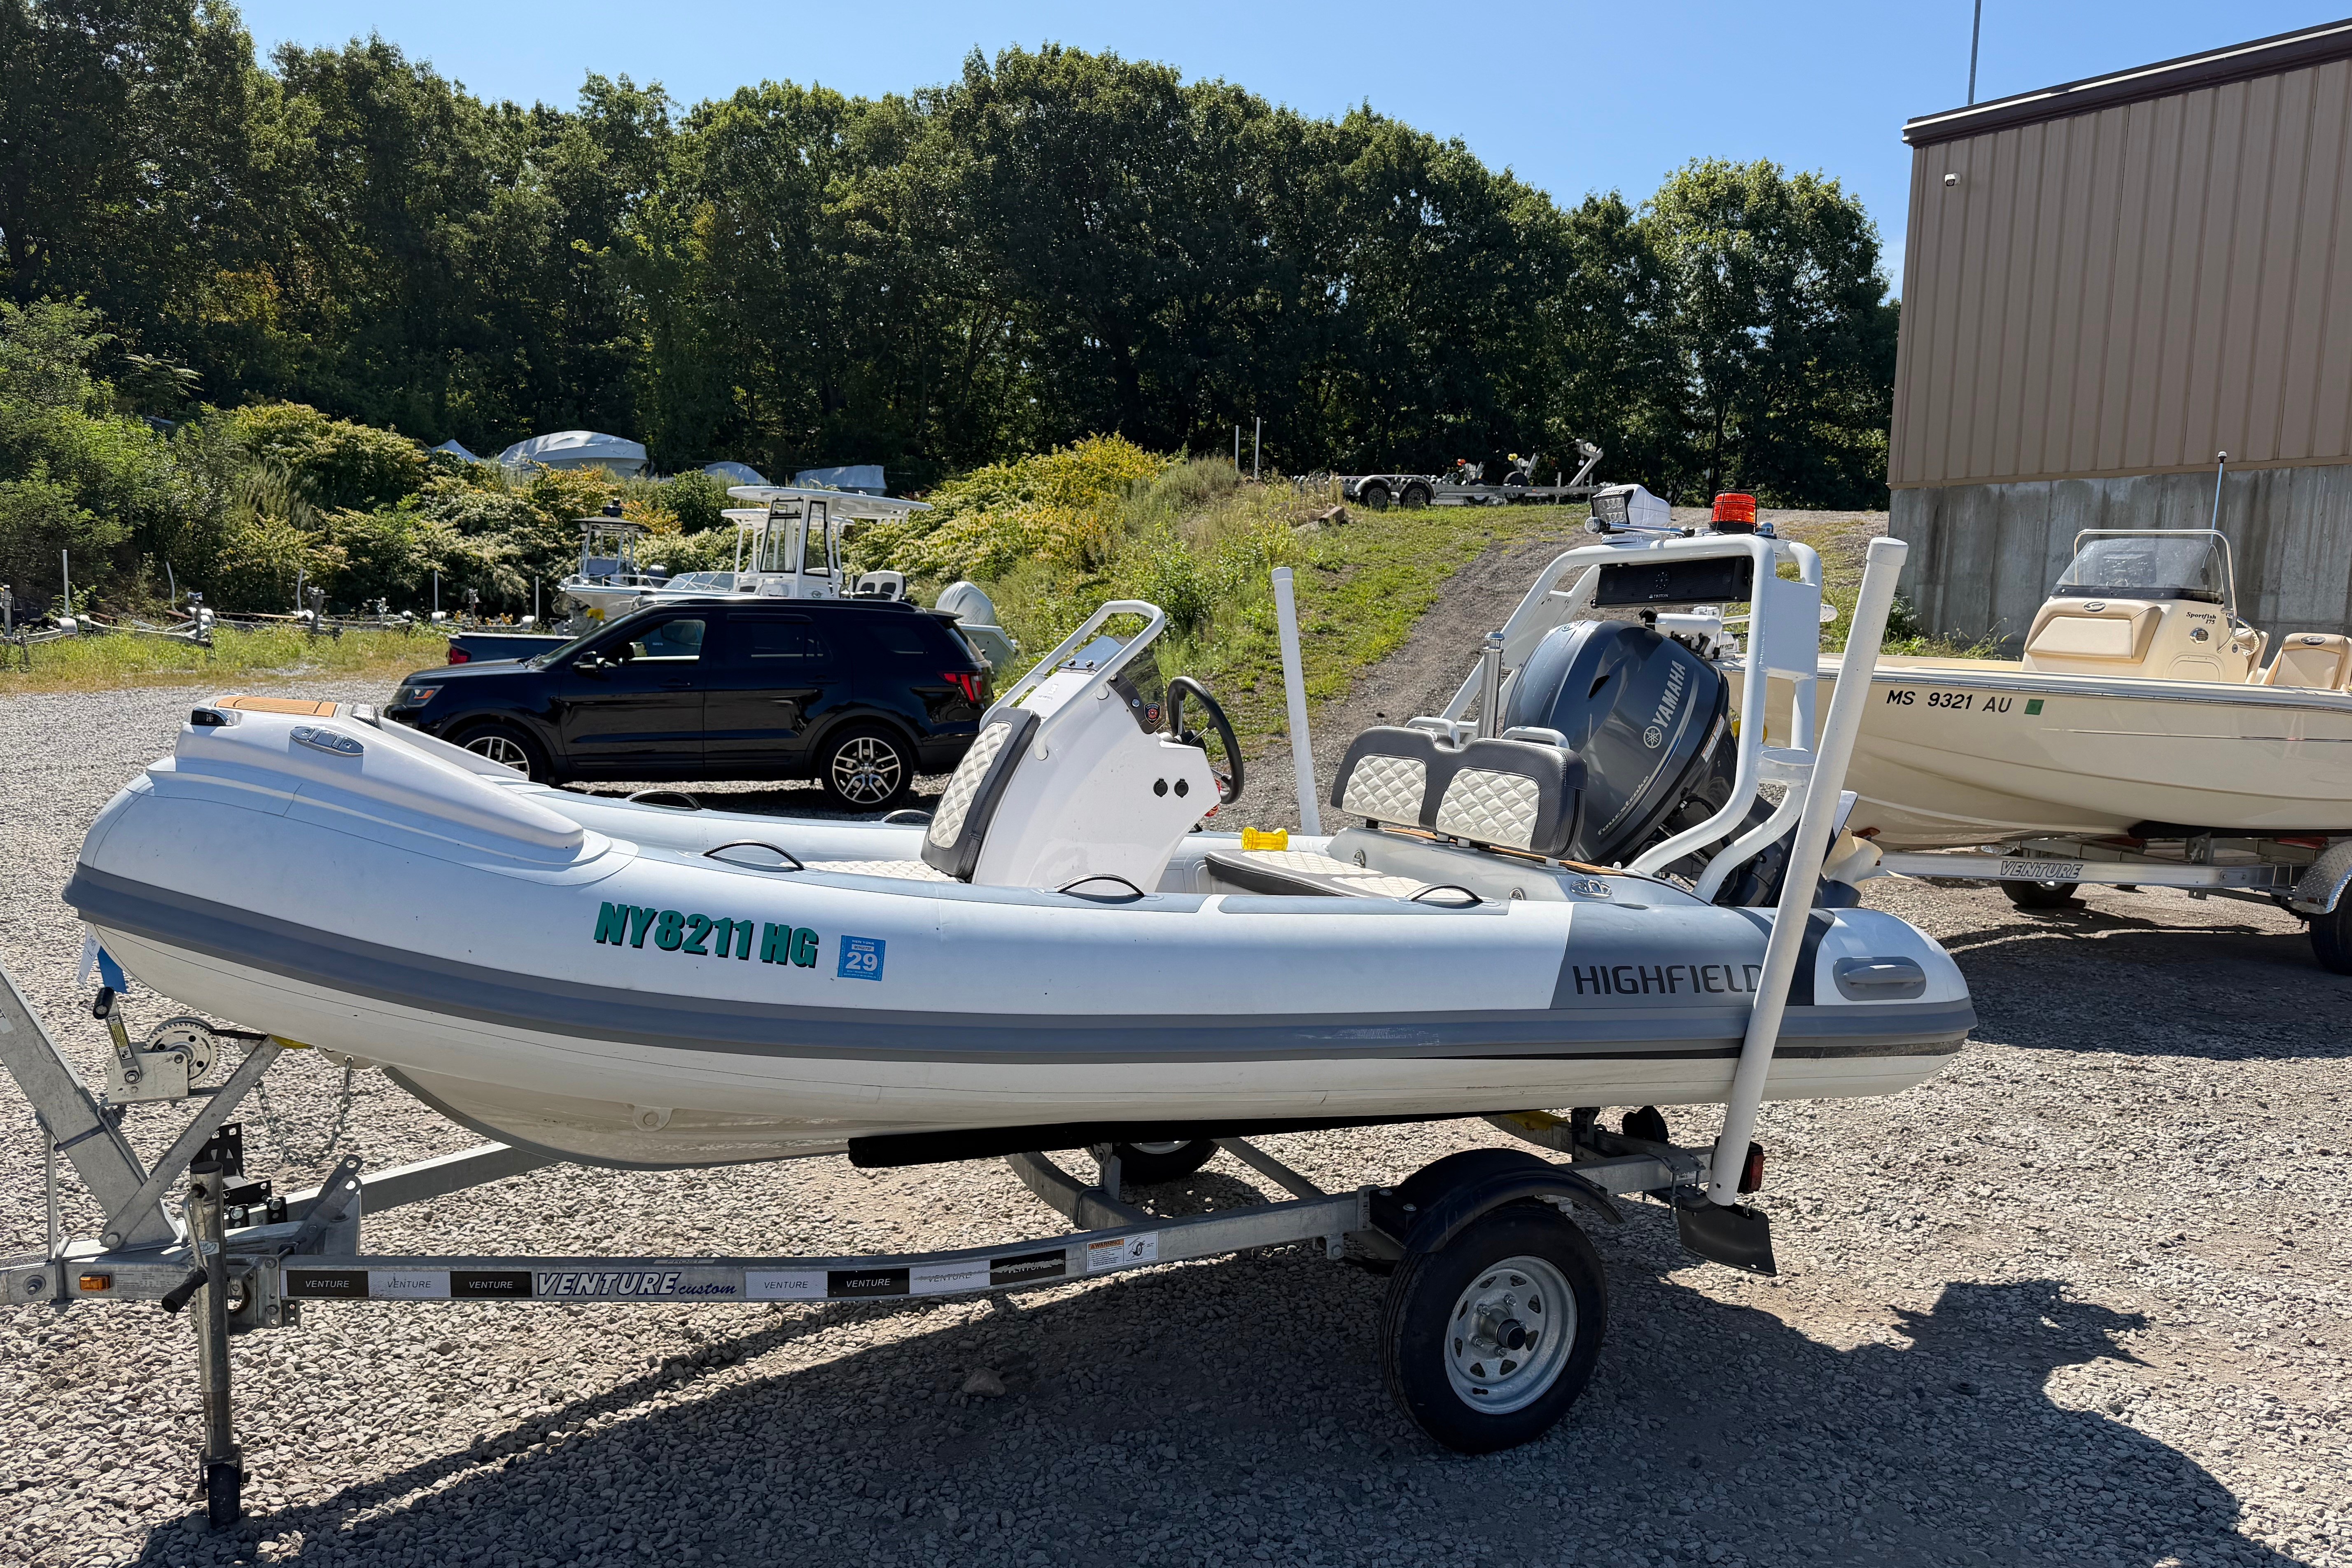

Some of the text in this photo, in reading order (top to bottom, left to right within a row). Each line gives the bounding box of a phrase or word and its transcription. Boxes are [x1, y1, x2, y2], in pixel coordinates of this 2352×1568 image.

[1652, 660, 1685, 728] YAMAHA
[1886, 690, 1916, 705] MS
[1927, 692, 1973, 709] 9321
[1982, 696, 2012, 713] AU
[2000, 861, 2084, 879] VENTURE
[593, 901, 819, 968] NY8211 HG
[845, 951, 878, 971] 29
[306, 1280, 350, 1288] VENTURE
[537, 1272, 737, 1296] VENTURE custom
[847, 1278, 891, 1288] VENTURE
